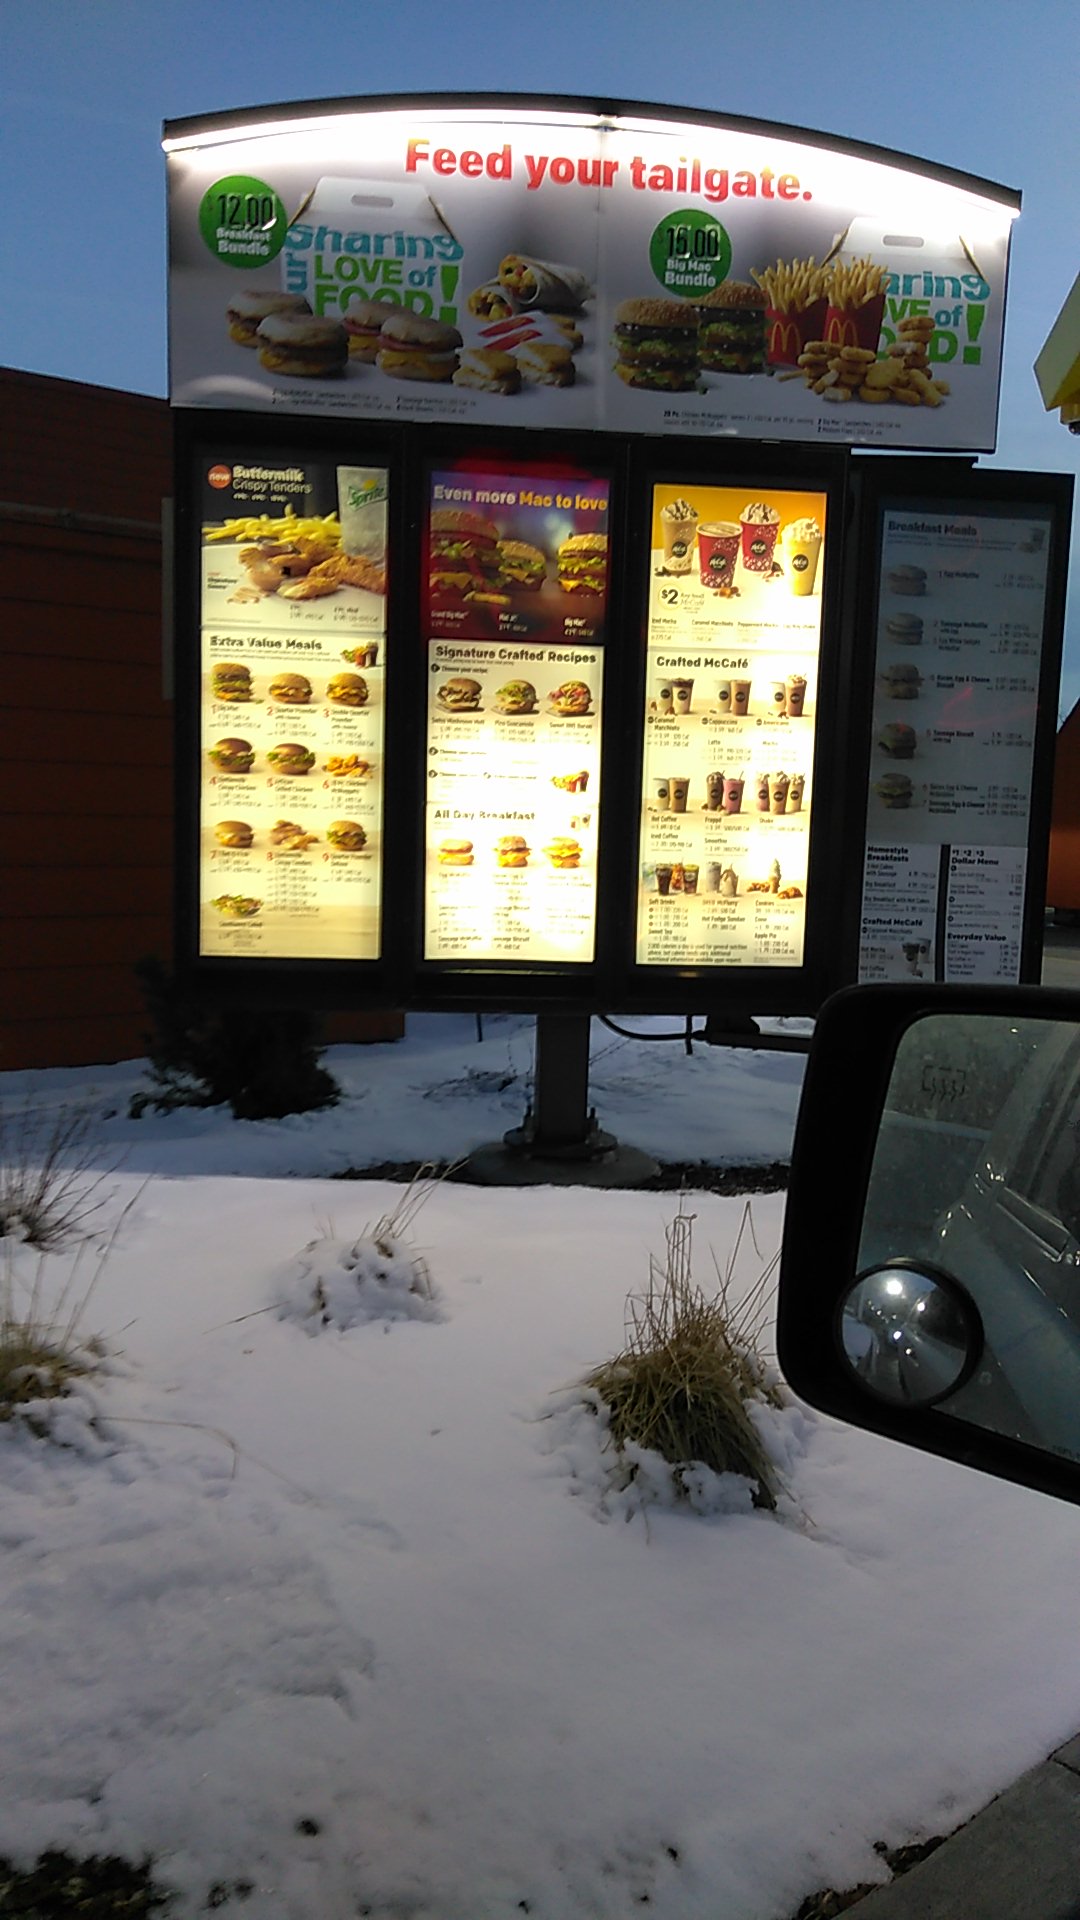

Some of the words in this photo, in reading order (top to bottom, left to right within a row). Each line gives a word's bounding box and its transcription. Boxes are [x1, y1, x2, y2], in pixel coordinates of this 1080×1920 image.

[405, 138, 513, 181] Feed
[525, 155, 619, 191] your
[630, 155, 813, 203] tailgate.
[216, 227, 271, 242] Breakfast
[286, 223, 465, 261] Sharing
[218, 240, 270, 256] Bundle
[315, 255, 403, 284] LOVE
[407, 265, 437, 288] of
[666, 259, 686, 272] Big
[688, 260, 712, 273] Mac
[664, 271, 716, 288] Bundle
[881, 270, 991, 302] aring
[934, 304, 963, 328] of
[208, 472, 231, 482] new
[233, 465, 304, 482] Buttermilk
[233, 479, 268, 493] Crispy
[269, 480, 314, 494] Tenders
[348, 485, 389, 511] Sprite
[434, 485, 472, 502] Even
[475, 490, 516, 505] more
[519, 492, 552, 507] Mac
[556, 494, 572, 508] to
[575, 495, 608, 511] love
[888, 520, 942, 535] Breakfast
[944, 522, 978, 536] Meals
[661, 588, 678, 605] $2
[210, 635, 244, 648] Extra
[247, 637, 282, 649] Value
[285, 639, 323, 650] Meals
[435, 646, 496, 660] Signature
[498, 648, 545, 661] Crafted
[548, 651, 597, 664] Recipes
[657, 656, 701, 667] Crafted
[704, 657, 749, 669] McCafé
[434, 810, 450, 819] All
[453, 810, 474, 820] Day
[479, 811, 536, 820] Breakfast
[867, 845, 909, 855] Homestyle
[867, 854, 909, 863] Breakfasts
[951, 857, 976, 865] Dollar
[977, 857, 999, 866] Menu
[862, 917, 893, 927] Crafted
[893, 918, 923, 927] McCafé
[948, 933, 983, 943] Everyday
[984, 933, 1007, 942] Value
